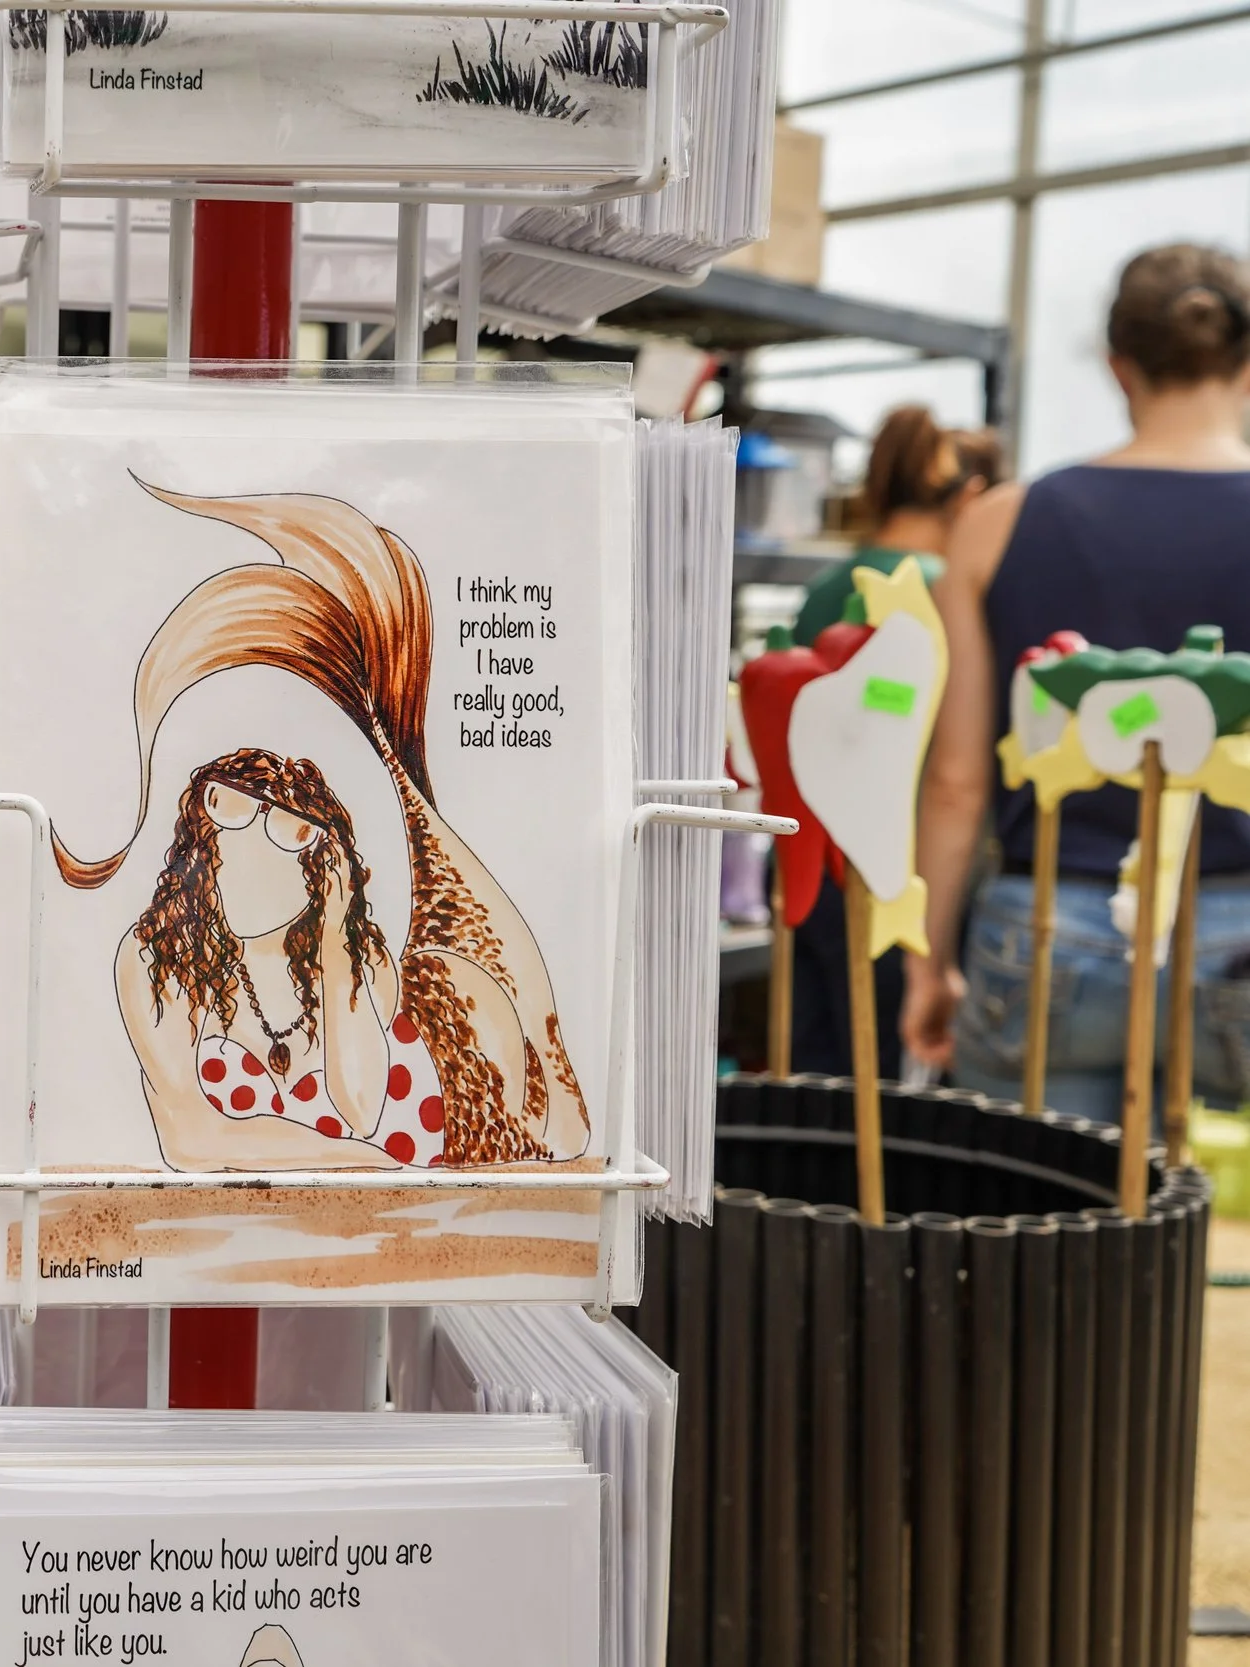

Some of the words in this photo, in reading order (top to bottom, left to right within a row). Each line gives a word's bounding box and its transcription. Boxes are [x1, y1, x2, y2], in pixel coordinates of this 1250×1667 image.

[90, 67, 135, 90] Linda
[140, 67, 204, 91] Finstad
[457, 576, 462, 602] I
[469, 575, 518, 604] think
[523, 584, 552, 611] my
[460, 612, 534, 648] problem
[540, 615, 557, 639] is
[477, 648, 482, 675] I
[489, 648, 534, 676] have
[453, 684, 505, 719] really
[512, 684, 565, 719] good,
[460, 721, 495, 748] bad
[501, 720, 552, 748] ideas
[40, 1257, 81, 1279] Linda
[85, 1256, 143, 1278] Finstad
[22, 1540, 69, 1574] You
[76, 1550, 142, 1572] never
[150, 1538, 213, 1573] know
[221, 1537, 268, 1570] how
[276, 1534, 339, 1568] weird
[346, 1544, 388, 1576] you
[395, 1543, 433, 1566] are
[21, 1582, 70, 1615] until
[78, 1592, 120, 1624] you
[128, 1581, 182, 1614] have
[190, 1591, 204, 1613] a
[212, 1578, 247, 1613] kid
[254, 1577, 301, 1610] who
[309, 1581, 361, 1610] acts
[14, 1629, 66, 1667] just
[74, 1623, 113, 1658] like
[120, 1634, 168, 1665] you.
